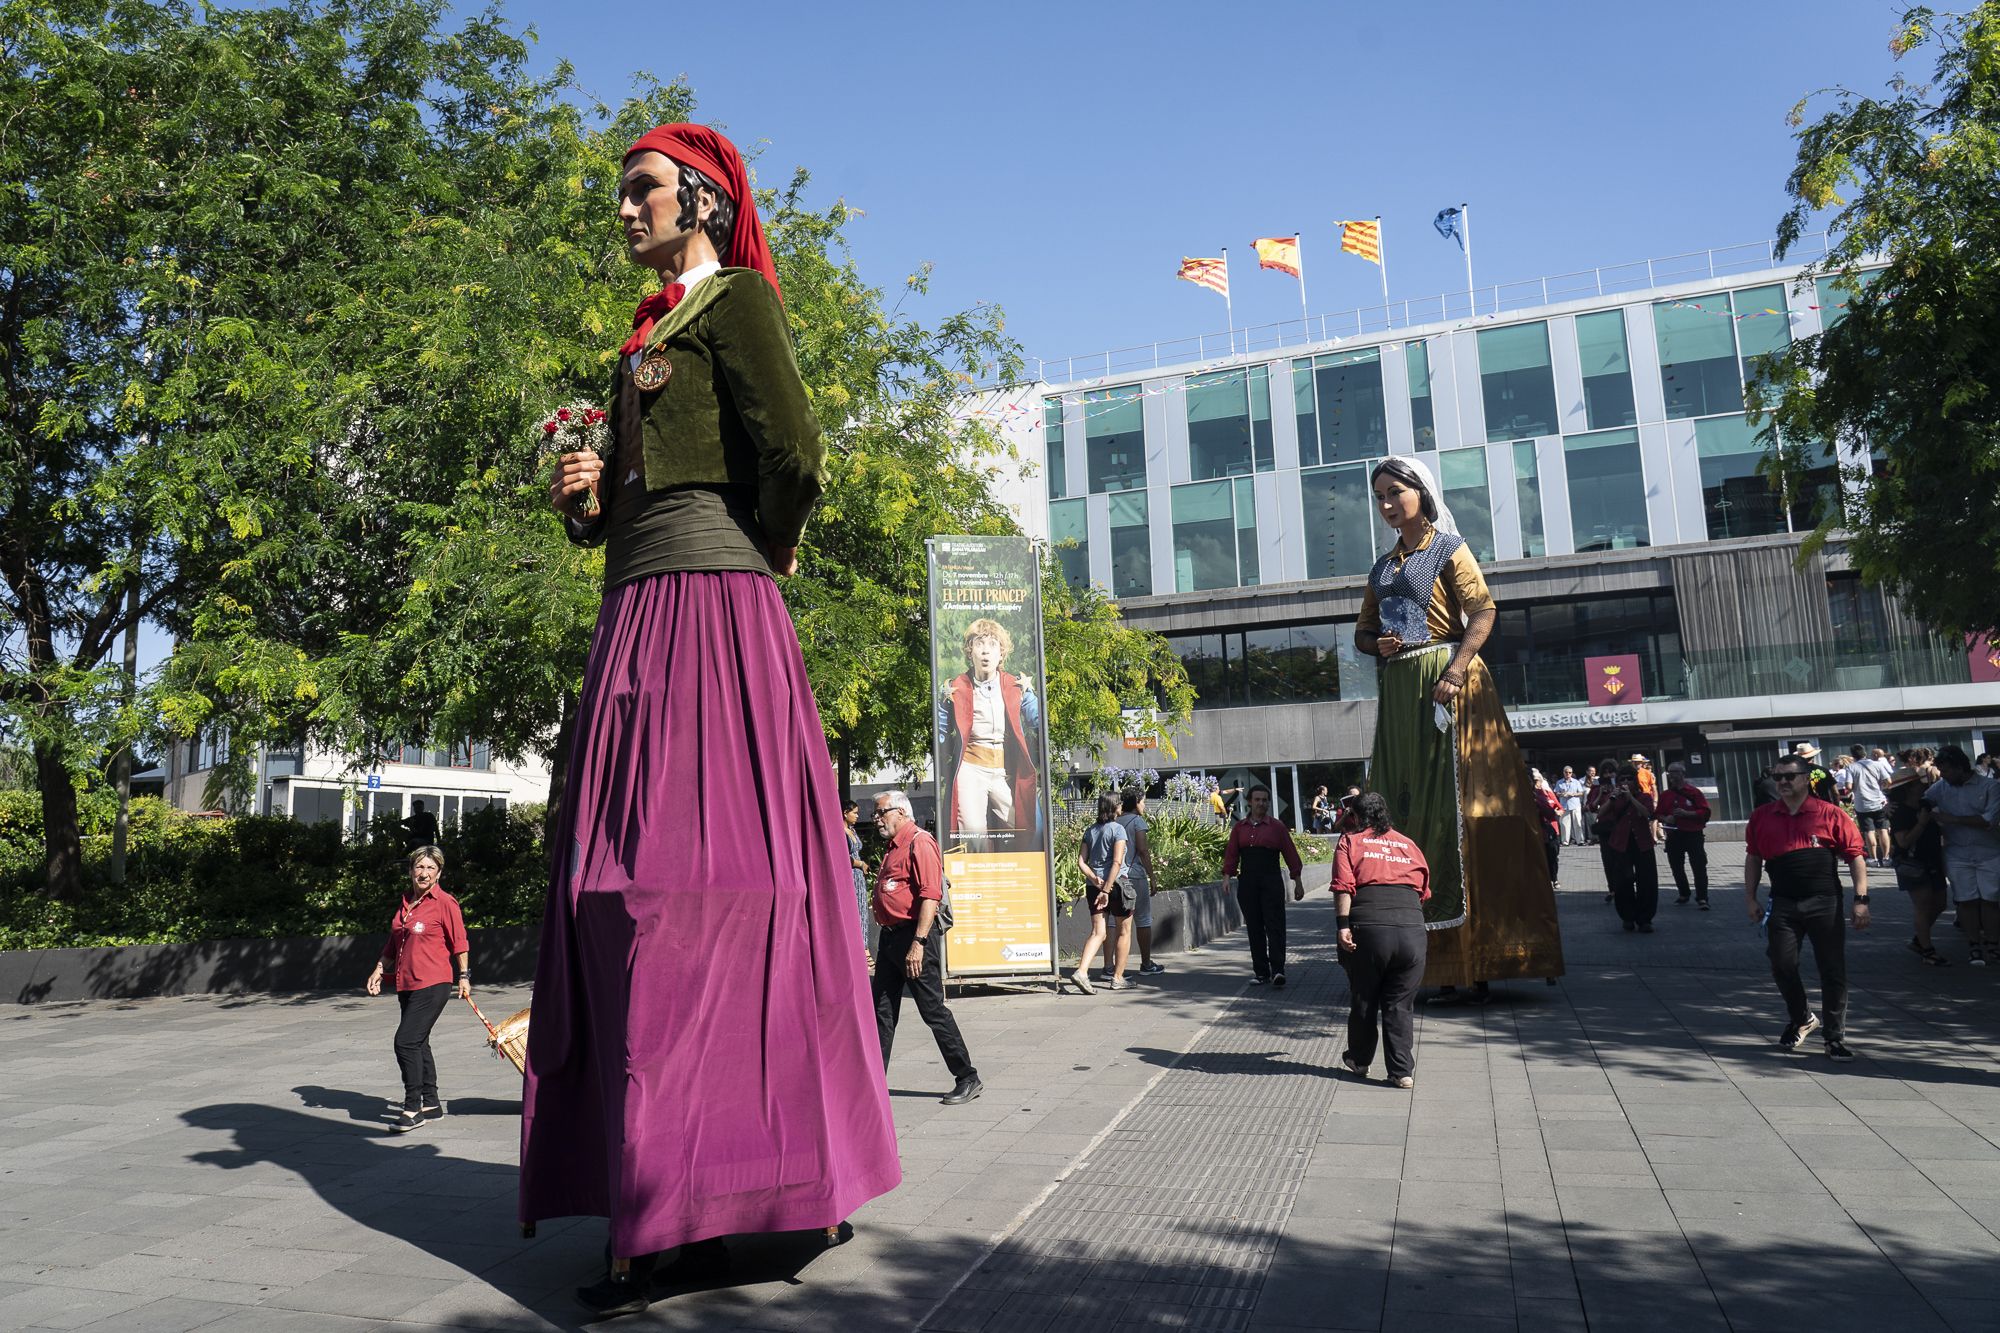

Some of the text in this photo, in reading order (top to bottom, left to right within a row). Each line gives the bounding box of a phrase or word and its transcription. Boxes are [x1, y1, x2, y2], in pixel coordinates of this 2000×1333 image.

[943, 587, 1027, 603] EL PETIT PRÍNCEP
[981, 603, 1022, 612] Saint-Exupéry
[1530, 713, 1548, 727] de
[1552, 712, 1589, 726] Sant
[1592, 710, 1638, 725] Cugat
[1385, 856, 1412, 864] CUGAT
